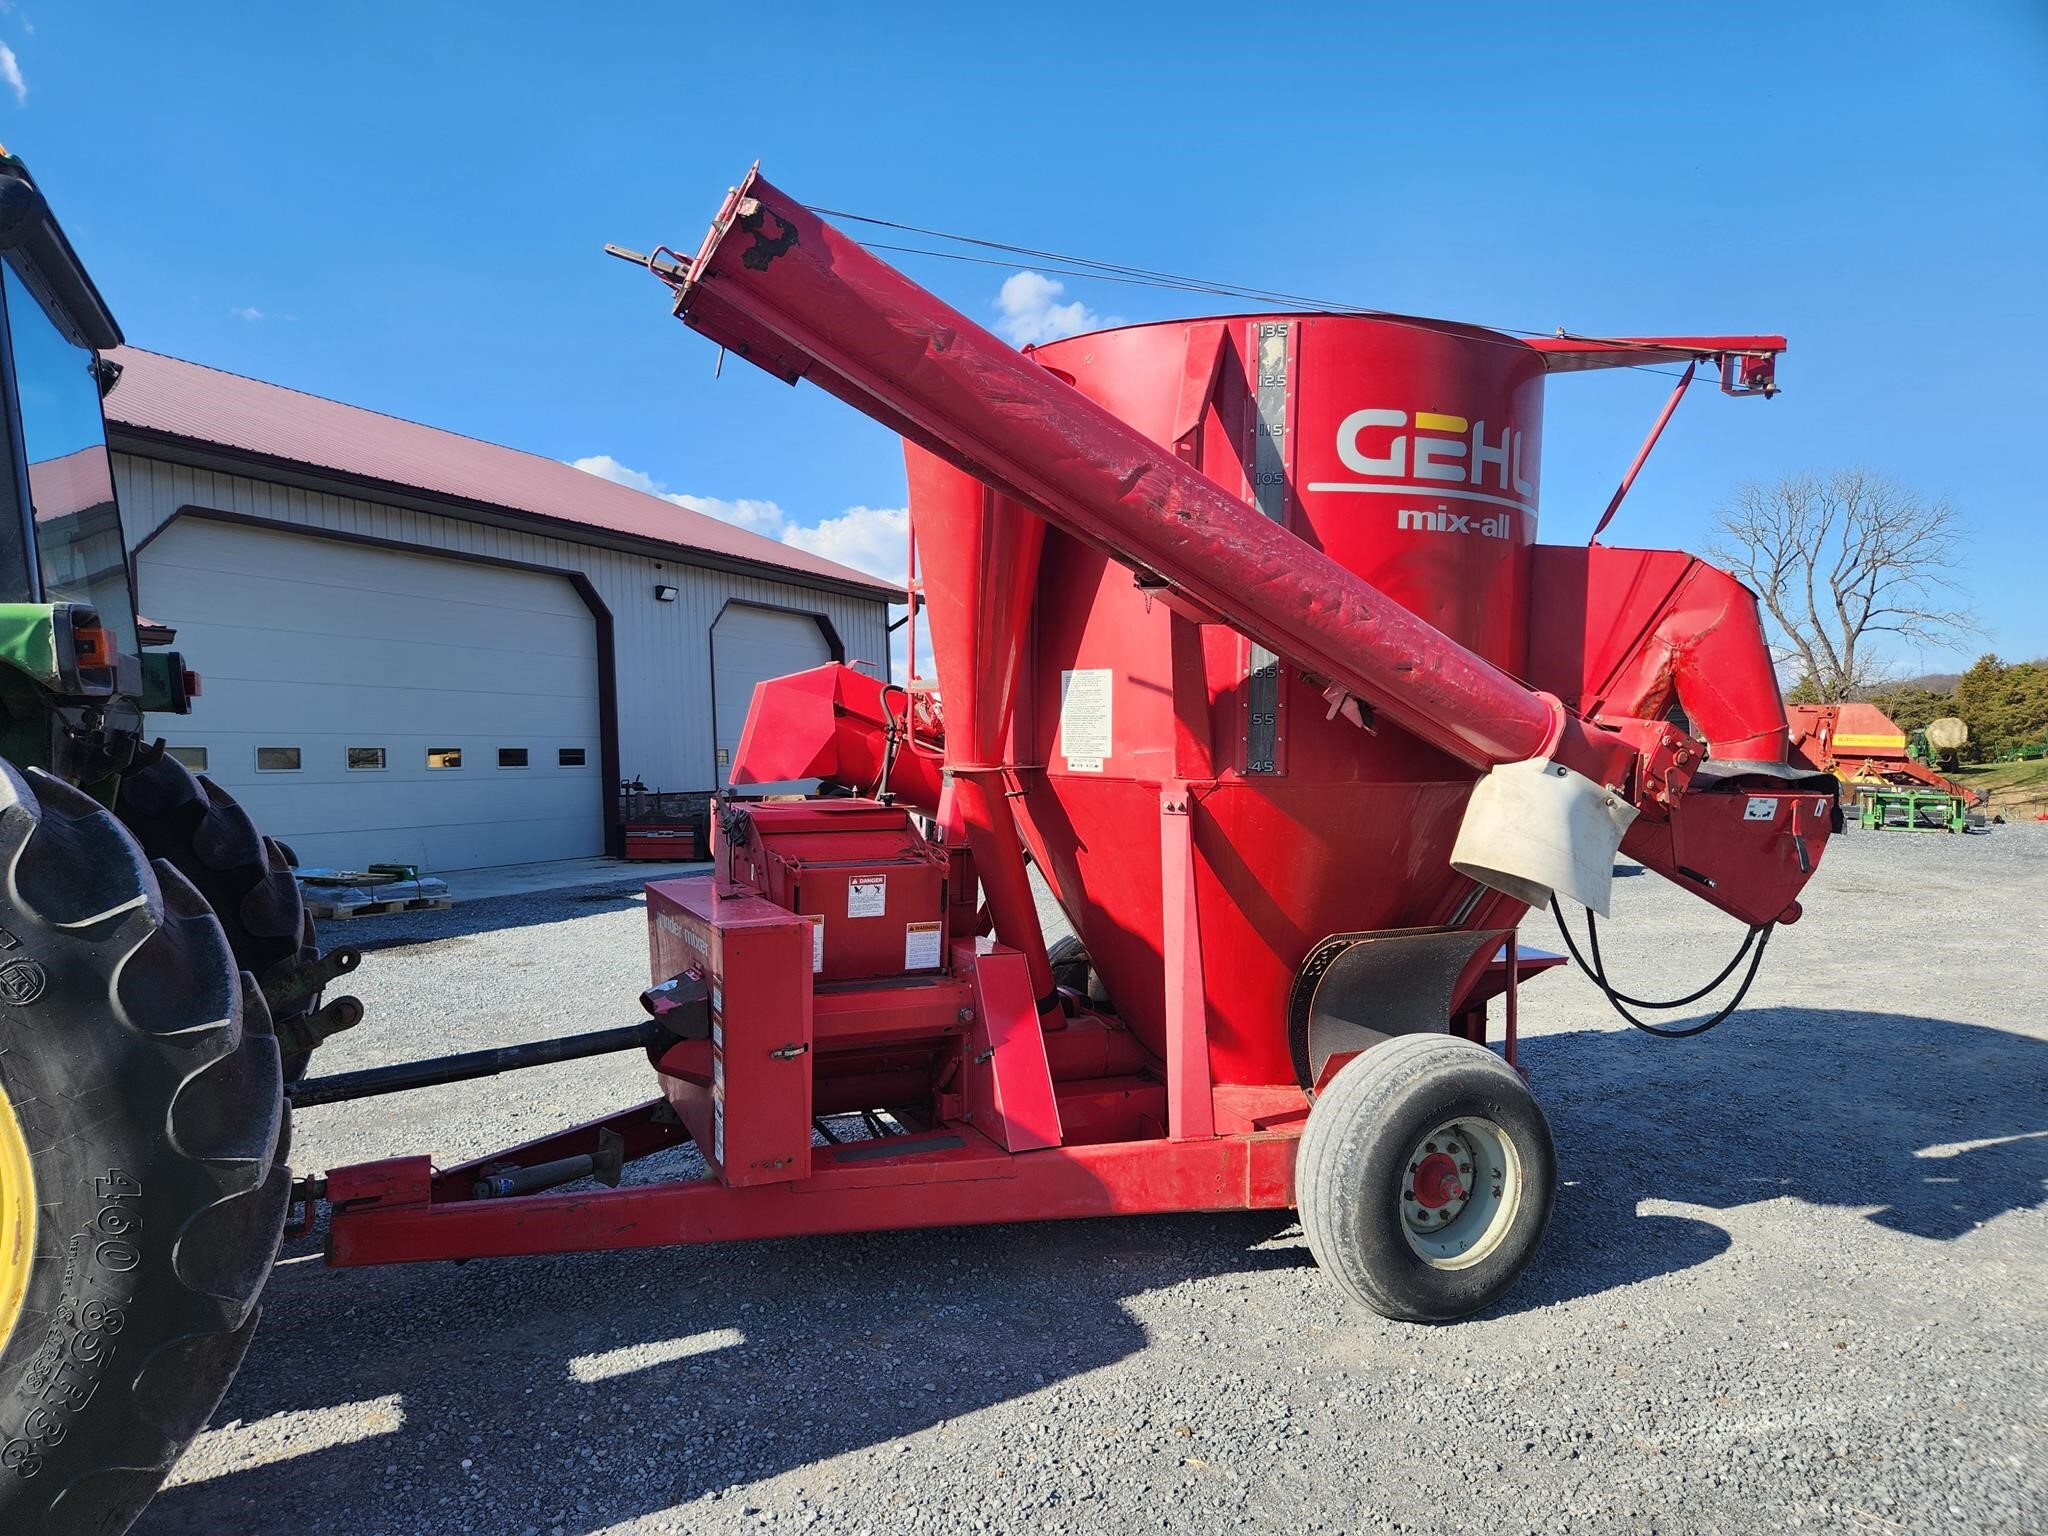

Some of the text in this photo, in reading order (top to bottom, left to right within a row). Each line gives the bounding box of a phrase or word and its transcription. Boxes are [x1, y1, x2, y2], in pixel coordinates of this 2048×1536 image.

[1260, 325, 1288, 337] 135
[1258, 375, 1286, 387] 125
[1259, 424, 1283, 436] 115
[1336, 408, 1534, 498] GEHL
[1256, 474, 1284, 486] 105
[1398, 505, 1510, 540] mix-all
[1254, 667, 1277, 677] 65
[1252, 713, 1274, 725] 55
[1252, 761, 1274, 772] 45
